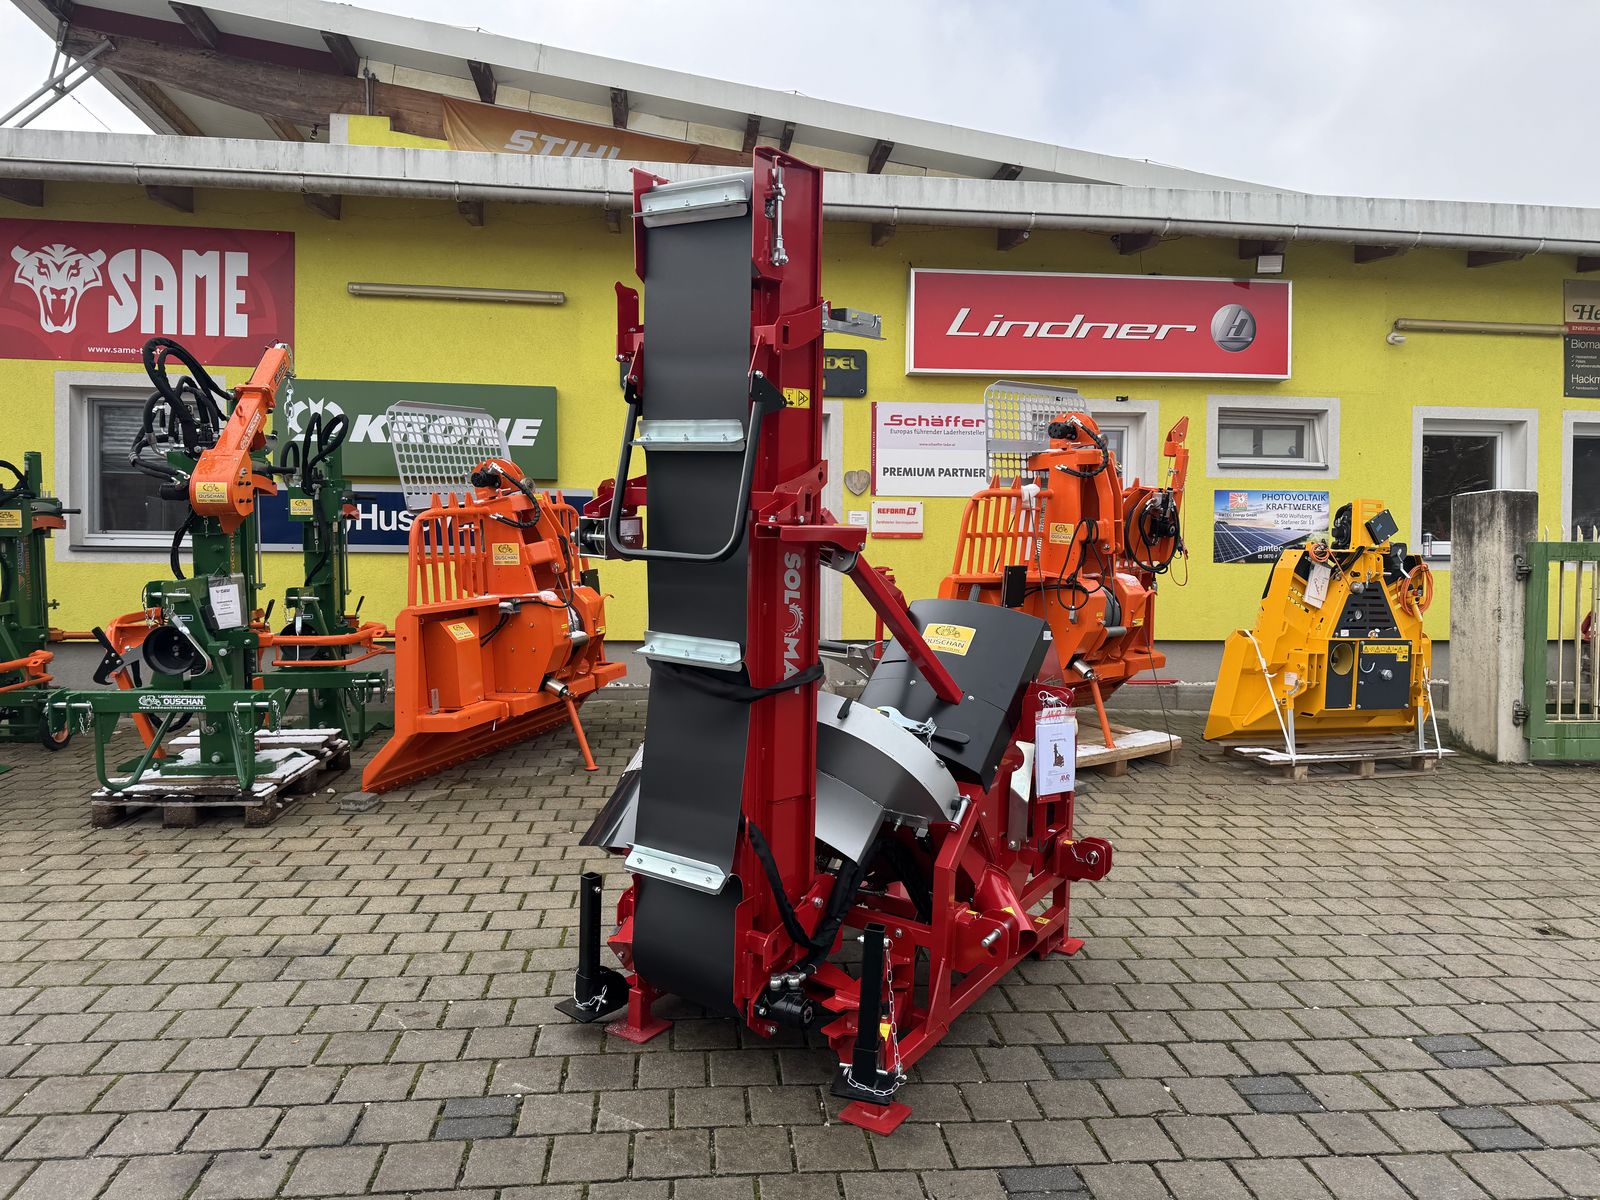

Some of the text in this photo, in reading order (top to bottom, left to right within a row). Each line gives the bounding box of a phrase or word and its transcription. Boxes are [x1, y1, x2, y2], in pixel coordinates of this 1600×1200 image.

[107, 248, 248, 337] SAME
[946, 308, 1197, 340] Lindner
[884, 414, 985, 427] Schäffer
[882, 467, 986, 478] PREMIUM PARTNER
[1262, 493, 1326, 501] PHOTOVOLTAIK
[1266, 503, 1322, 511] KRAFTWERKE
